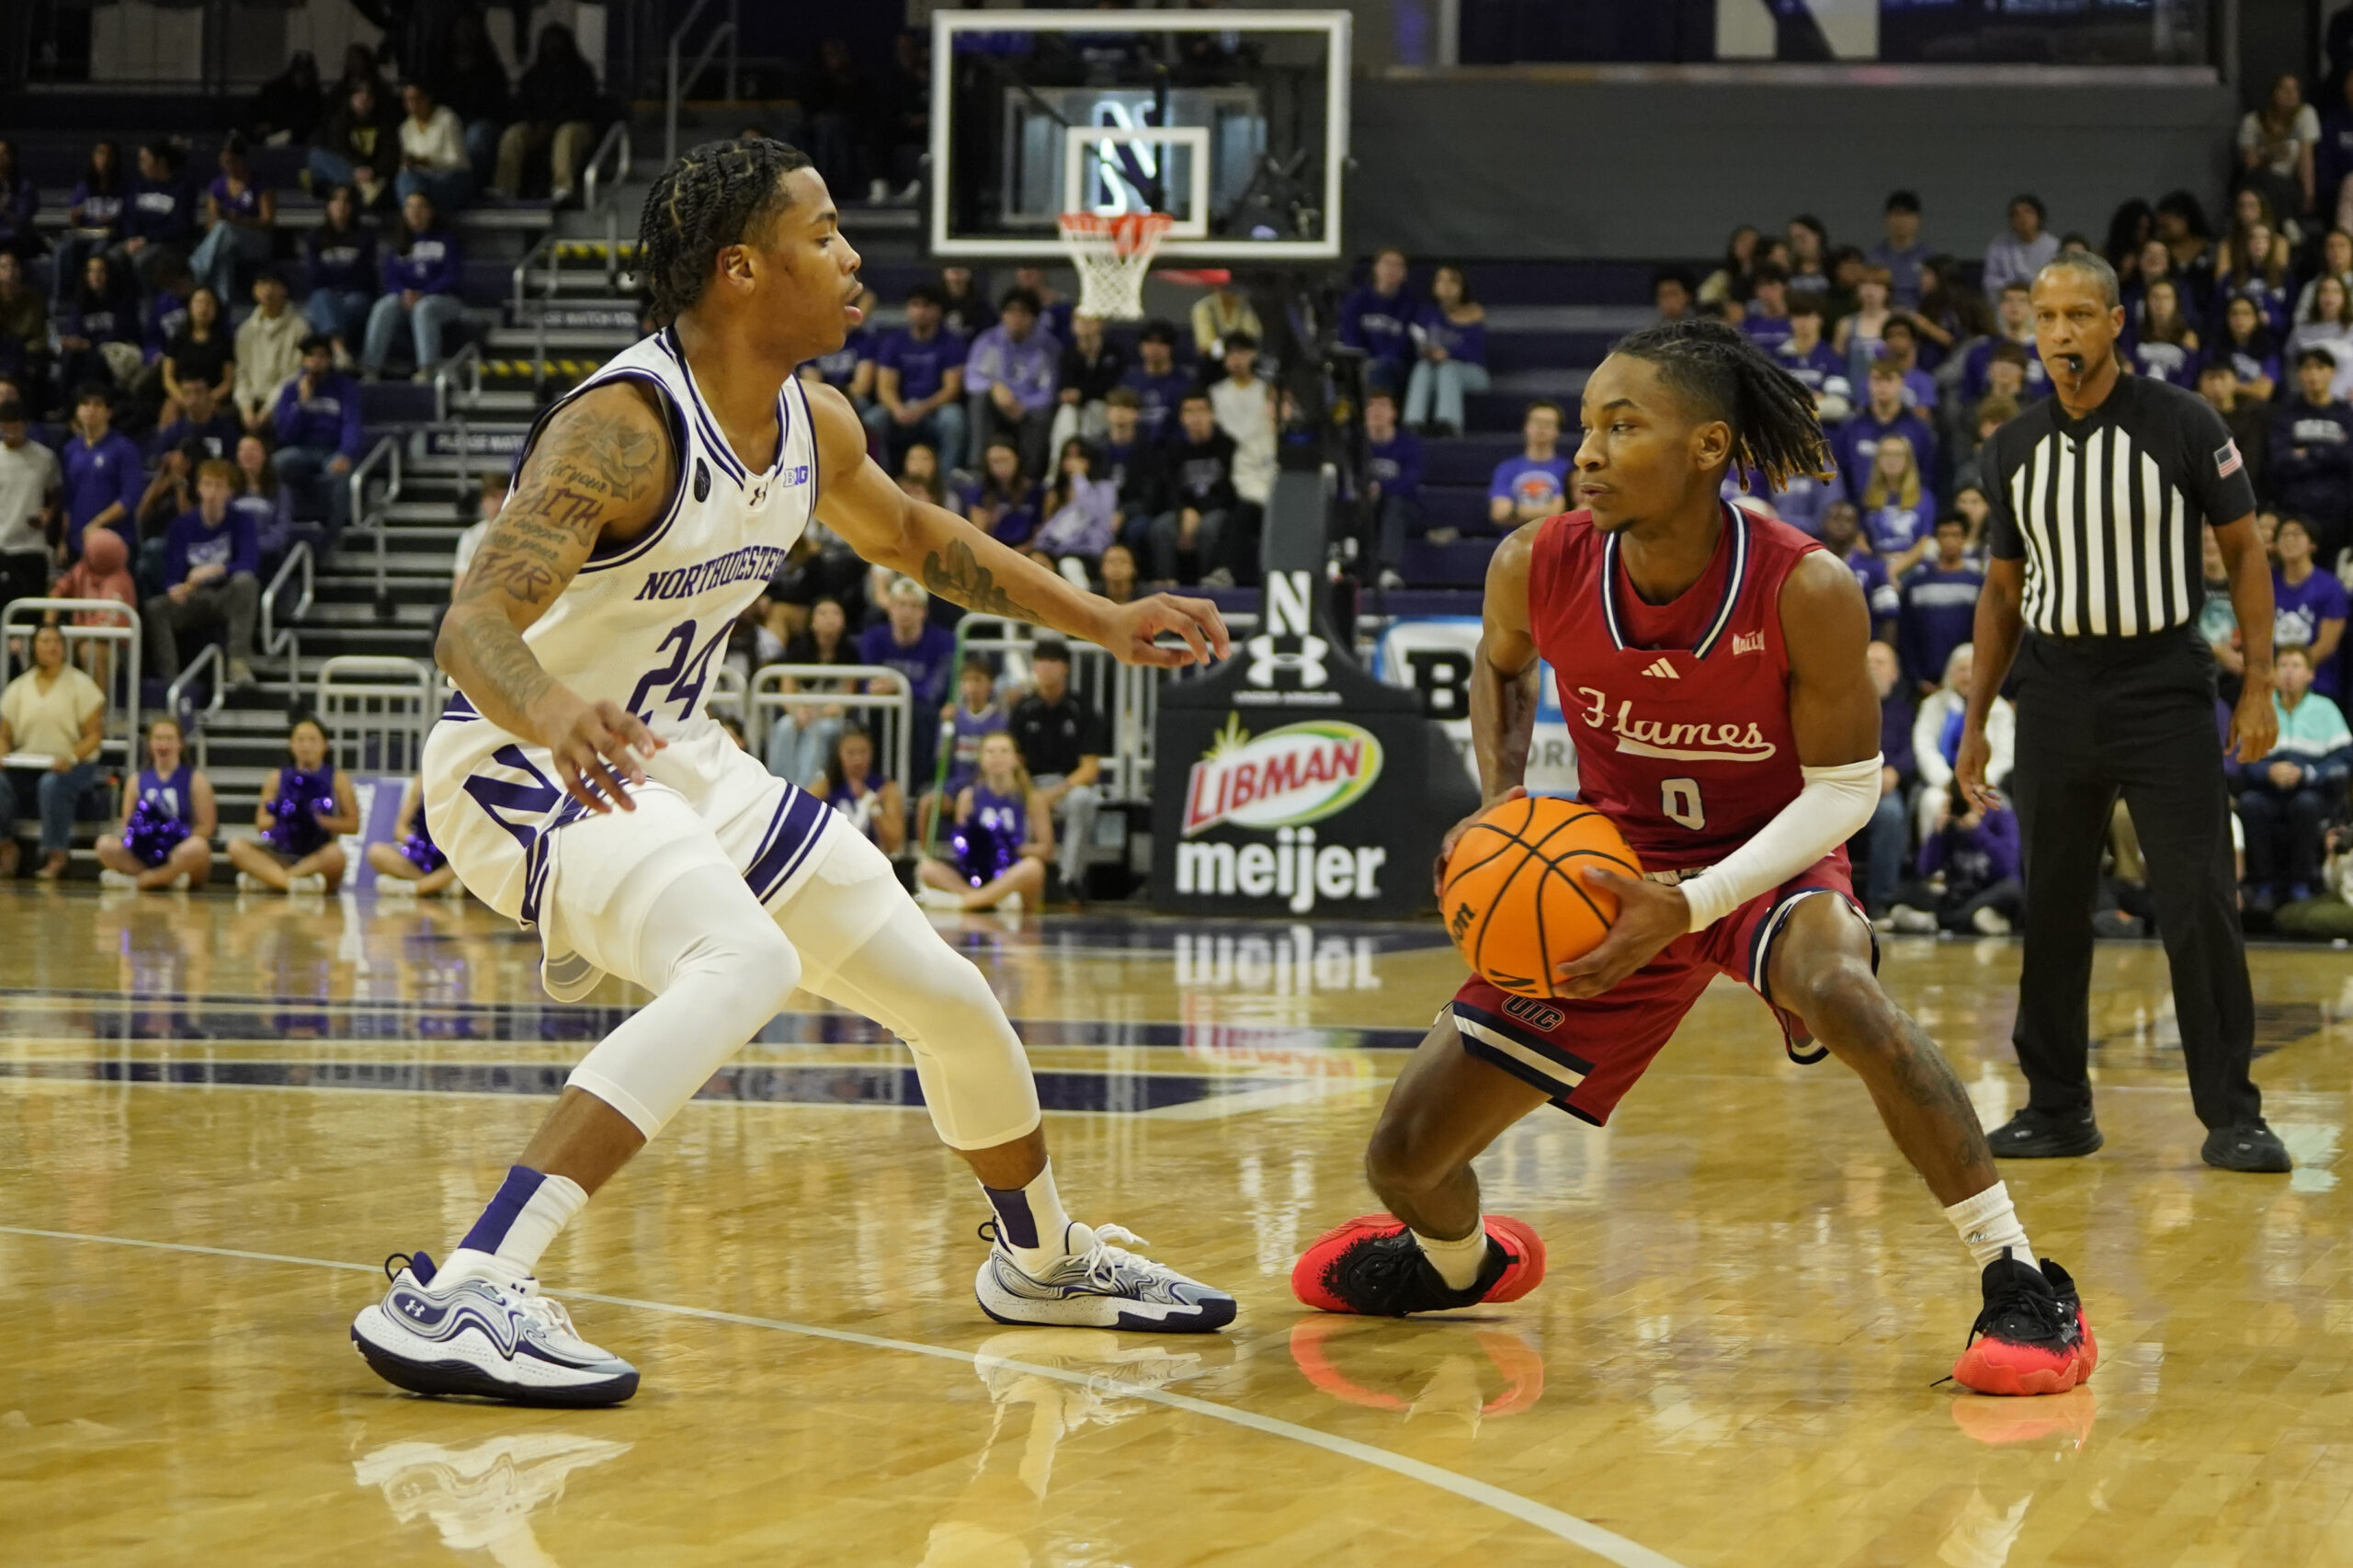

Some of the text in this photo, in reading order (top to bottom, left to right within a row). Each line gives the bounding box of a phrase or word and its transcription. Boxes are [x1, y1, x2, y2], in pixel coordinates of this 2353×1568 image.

[1266, 570, 1311, 637] N
[626, 617, 736, 723] 24
[1578, 687, 1776, 761] Flames
[1188, 741, 1361, 827] LIBMAN
[1661, 778, 1706, 831] 0
[1176, 826, 1386, 914] meijer
[1505, 994, 1563, 1030] UIC
